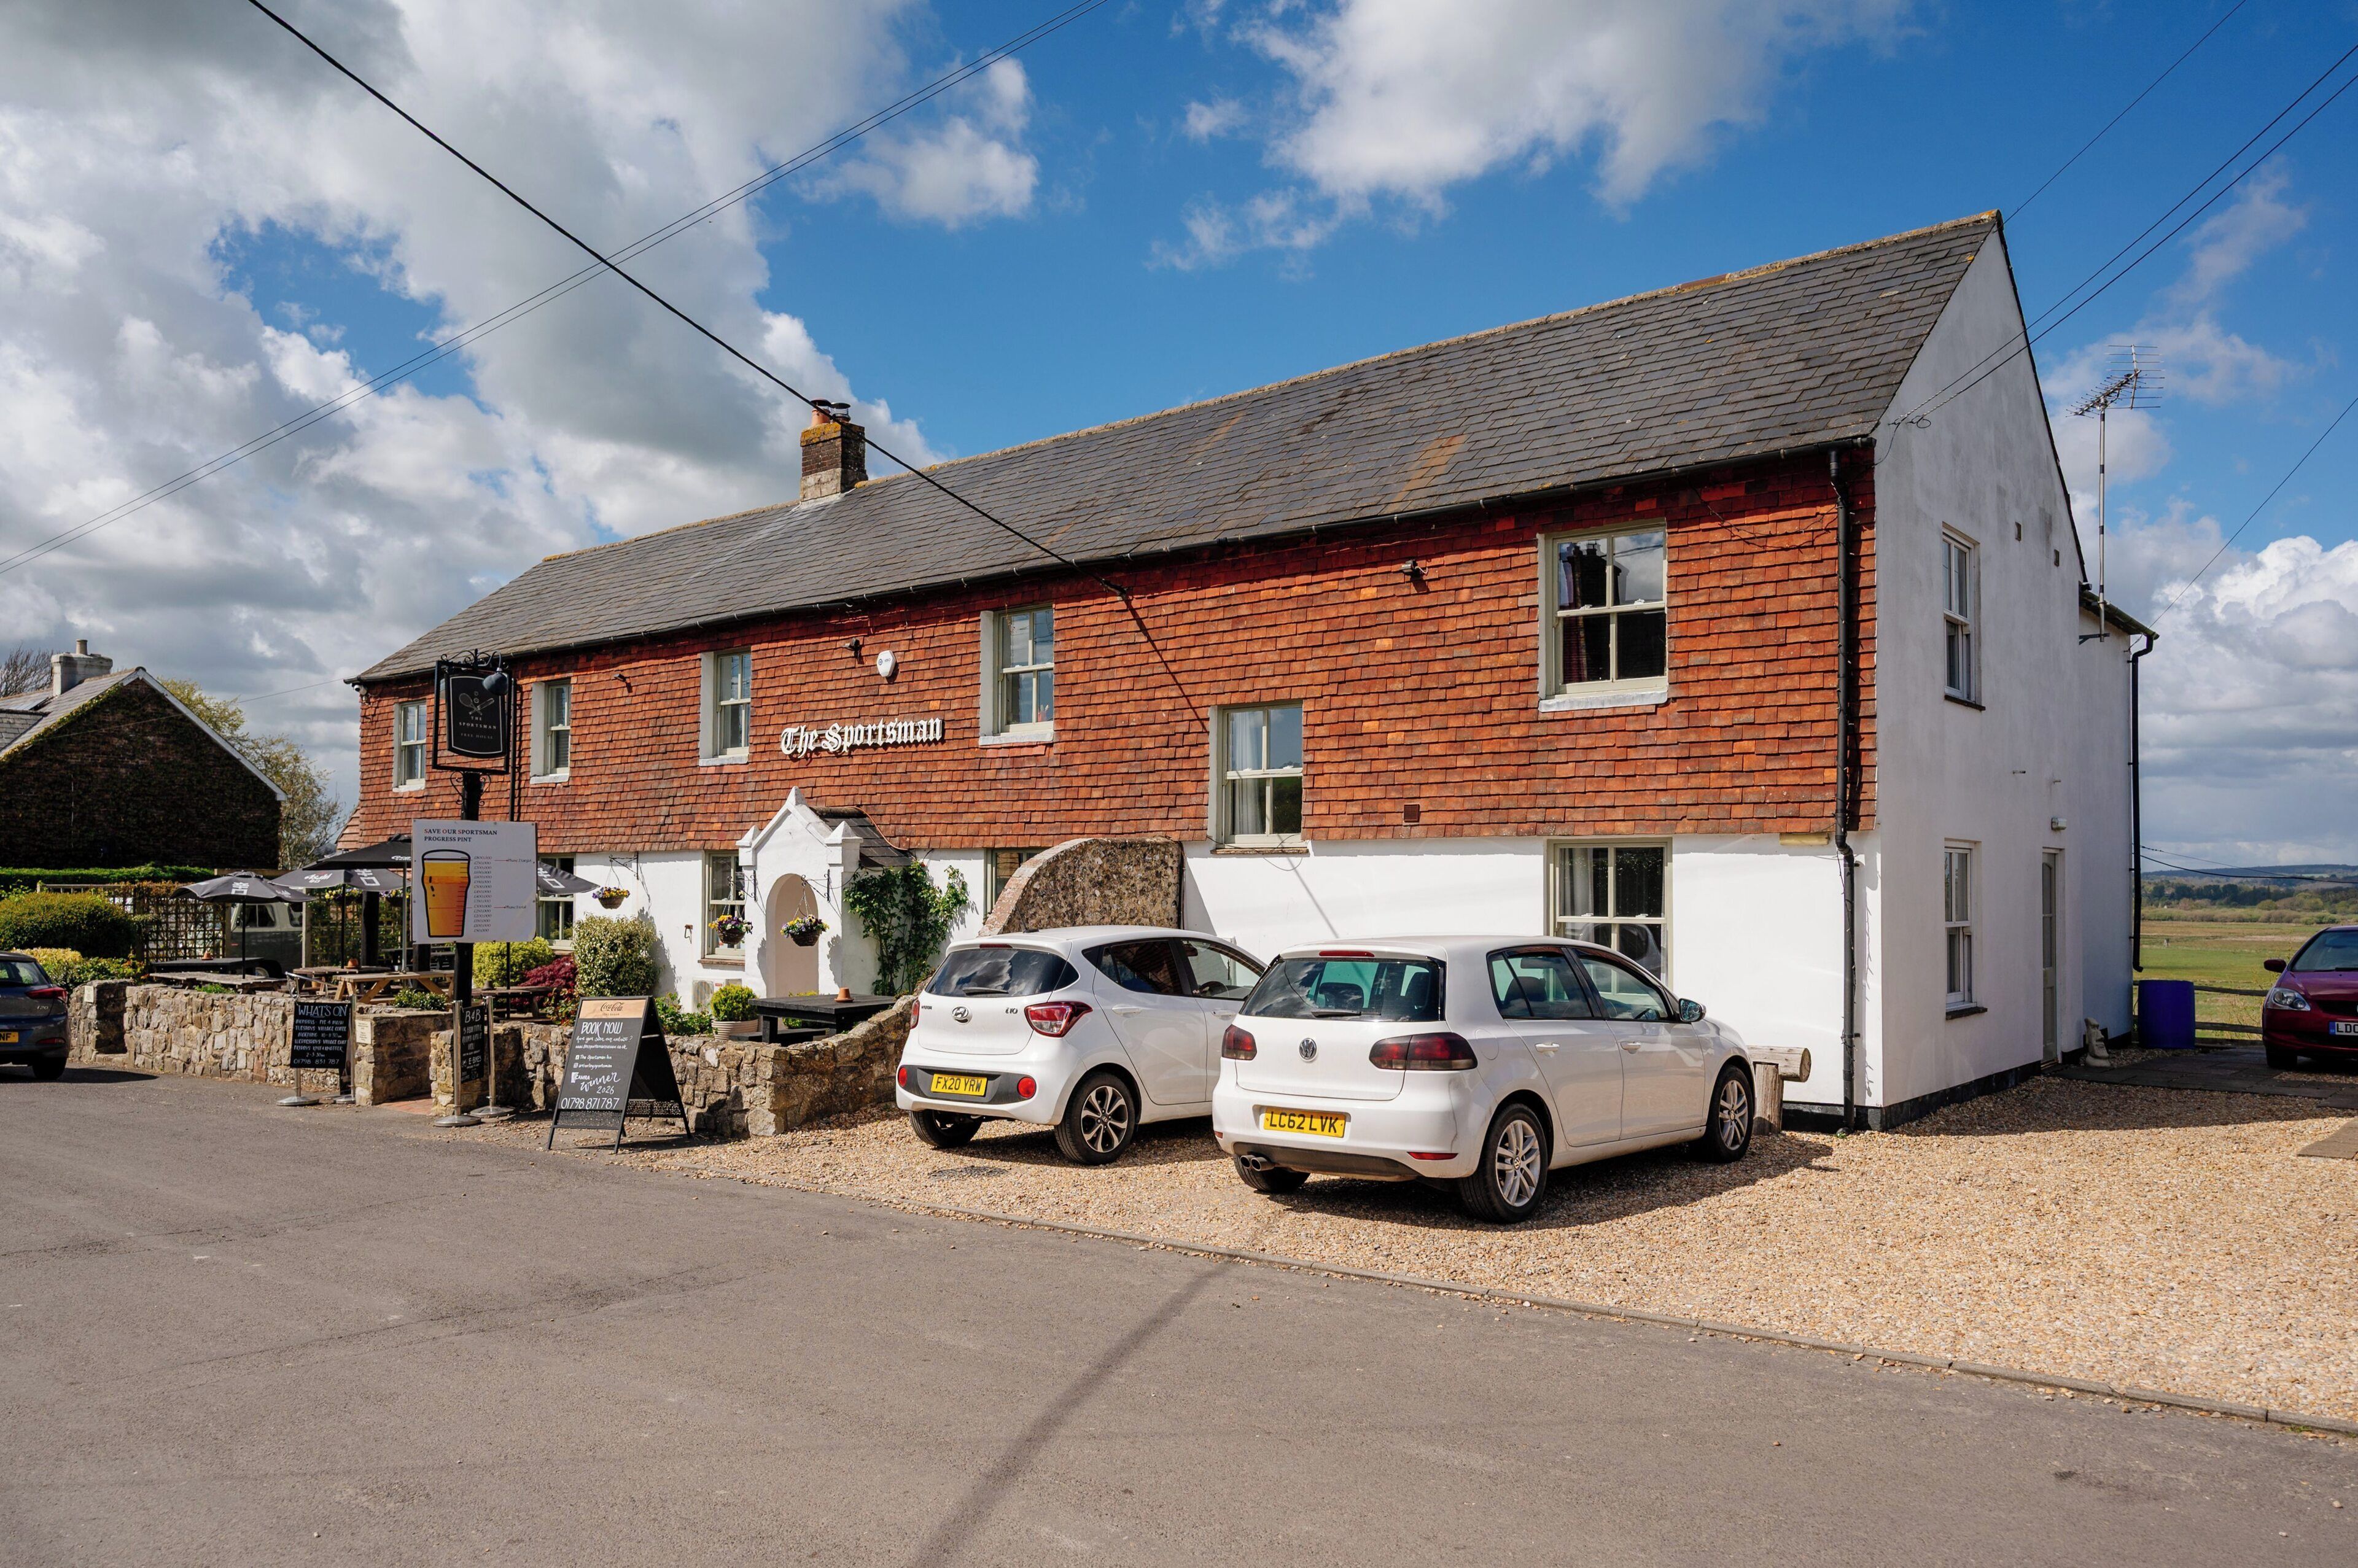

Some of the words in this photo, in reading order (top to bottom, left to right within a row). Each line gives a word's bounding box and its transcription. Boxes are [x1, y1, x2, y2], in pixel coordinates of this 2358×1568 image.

[780, 725, 819, 758] The
[821, 718, 942, 753] Sportsman
[298, 1005, 331, 1016] WHAT'S
[333, 1006, 348, 1017] ON
[465, 1009, 481, 1023] B&B
[581, 1022, 602, 1038] BOOK
[603, 1022, 623, 1034] NOW
[935, 1076, 961, 1090] FX20
[963, 1079, 982, 1092] YRW
[561, 1097, 585, 1109] 01798
[1269, 1111, 1305, 1130] LC62
[1309, 1115, 1339, 1133] LVK
